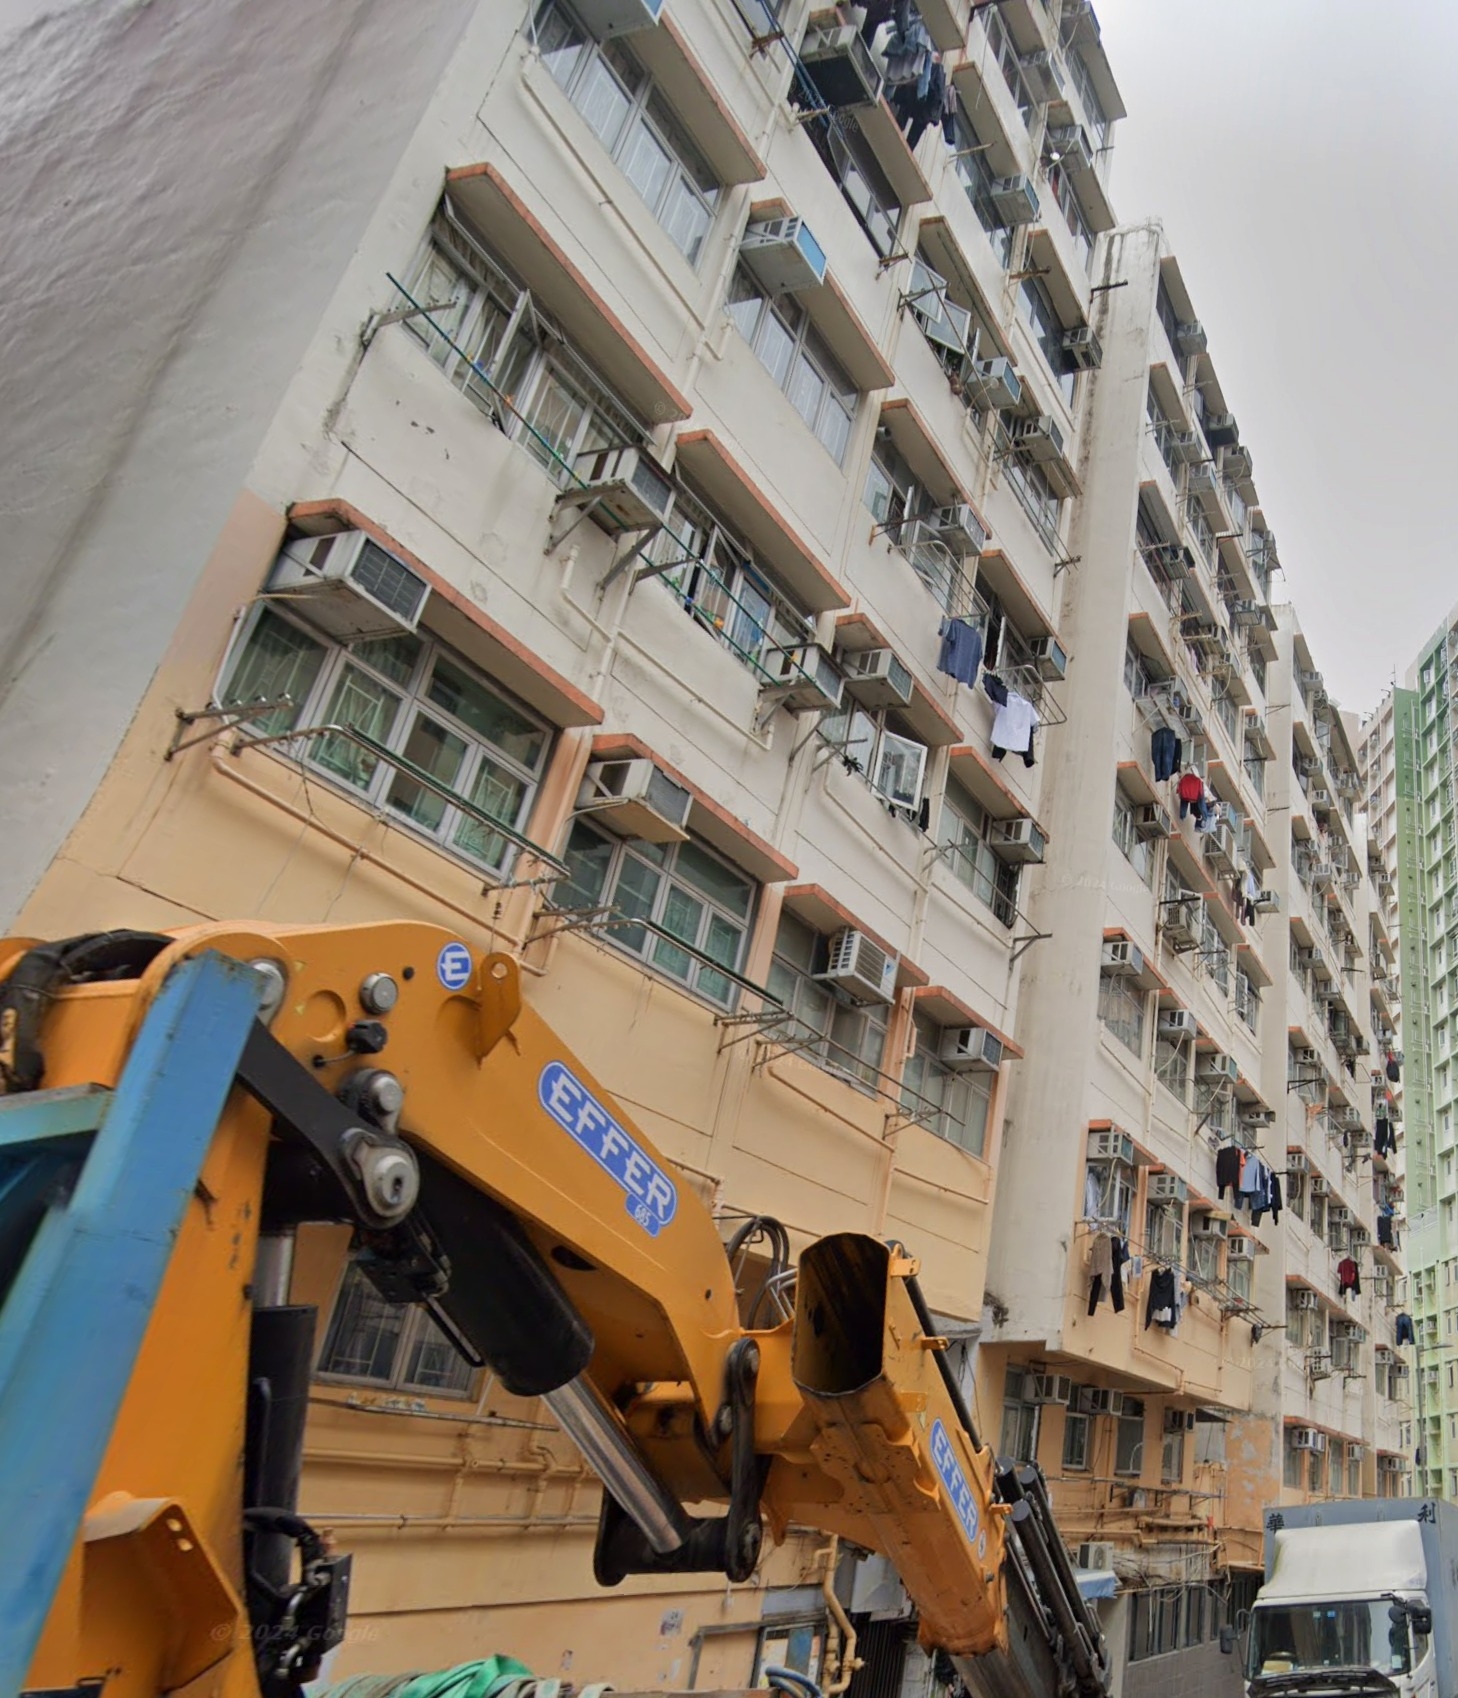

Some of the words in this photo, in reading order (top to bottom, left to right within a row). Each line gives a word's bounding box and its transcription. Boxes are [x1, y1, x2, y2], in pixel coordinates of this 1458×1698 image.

[440, 950, 470, 982] E
[547, 1072, 672, 1219] EFFER
[634, 1204, 652, 1227] 685
[933, 1427, 978, 1541] EFFER
